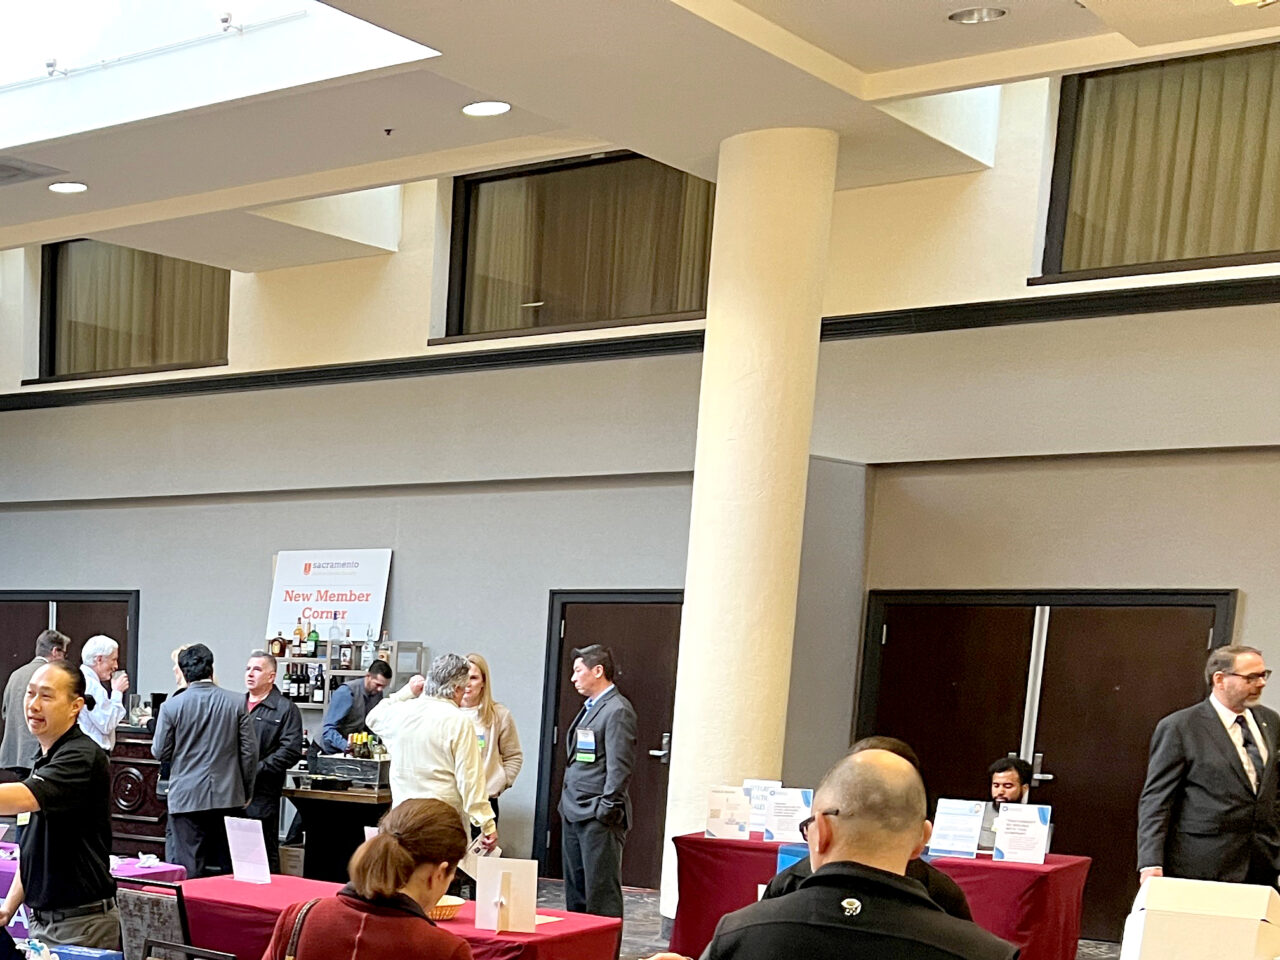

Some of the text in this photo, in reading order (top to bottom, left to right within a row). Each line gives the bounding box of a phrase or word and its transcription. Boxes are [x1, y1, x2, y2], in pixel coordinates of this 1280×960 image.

[283, 590, 371, 602] New Member
[302, 607, 348, 619] Corner
